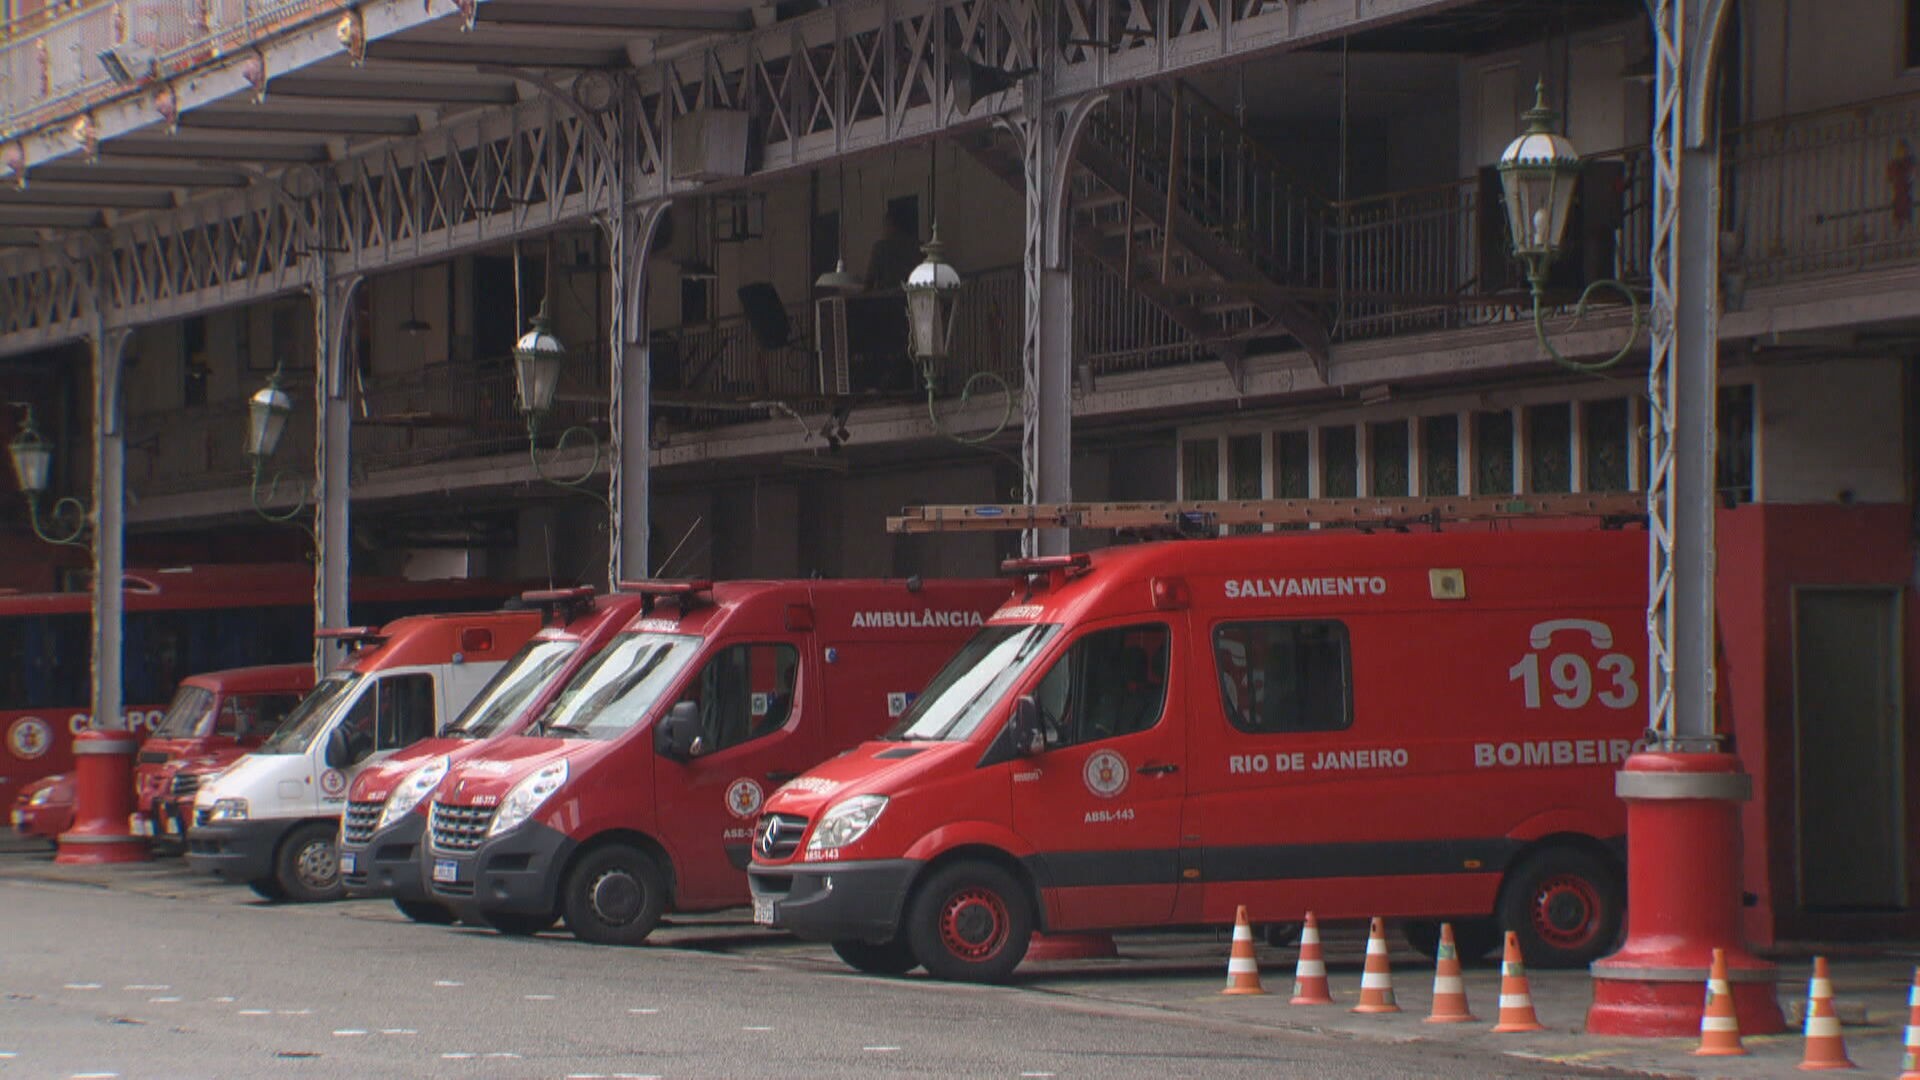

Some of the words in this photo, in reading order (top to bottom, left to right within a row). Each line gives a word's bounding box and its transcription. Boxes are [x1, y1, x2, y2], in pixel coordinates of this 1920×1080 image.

[1225, 576, 1386, 598] SALVAMENTO
[852, 608, 984, 628] AMBULÂNCIA
[1509, 653, 1639, 709] 193
[69, 710, 163, 735] CPO
[1229, 754, 1268, 774] RIO
[1276, 752, 1304, 772] DE
[1312, 748, 1408, 770] JANEIRO
[1084, 808, 1135, 823] ABSL-143
